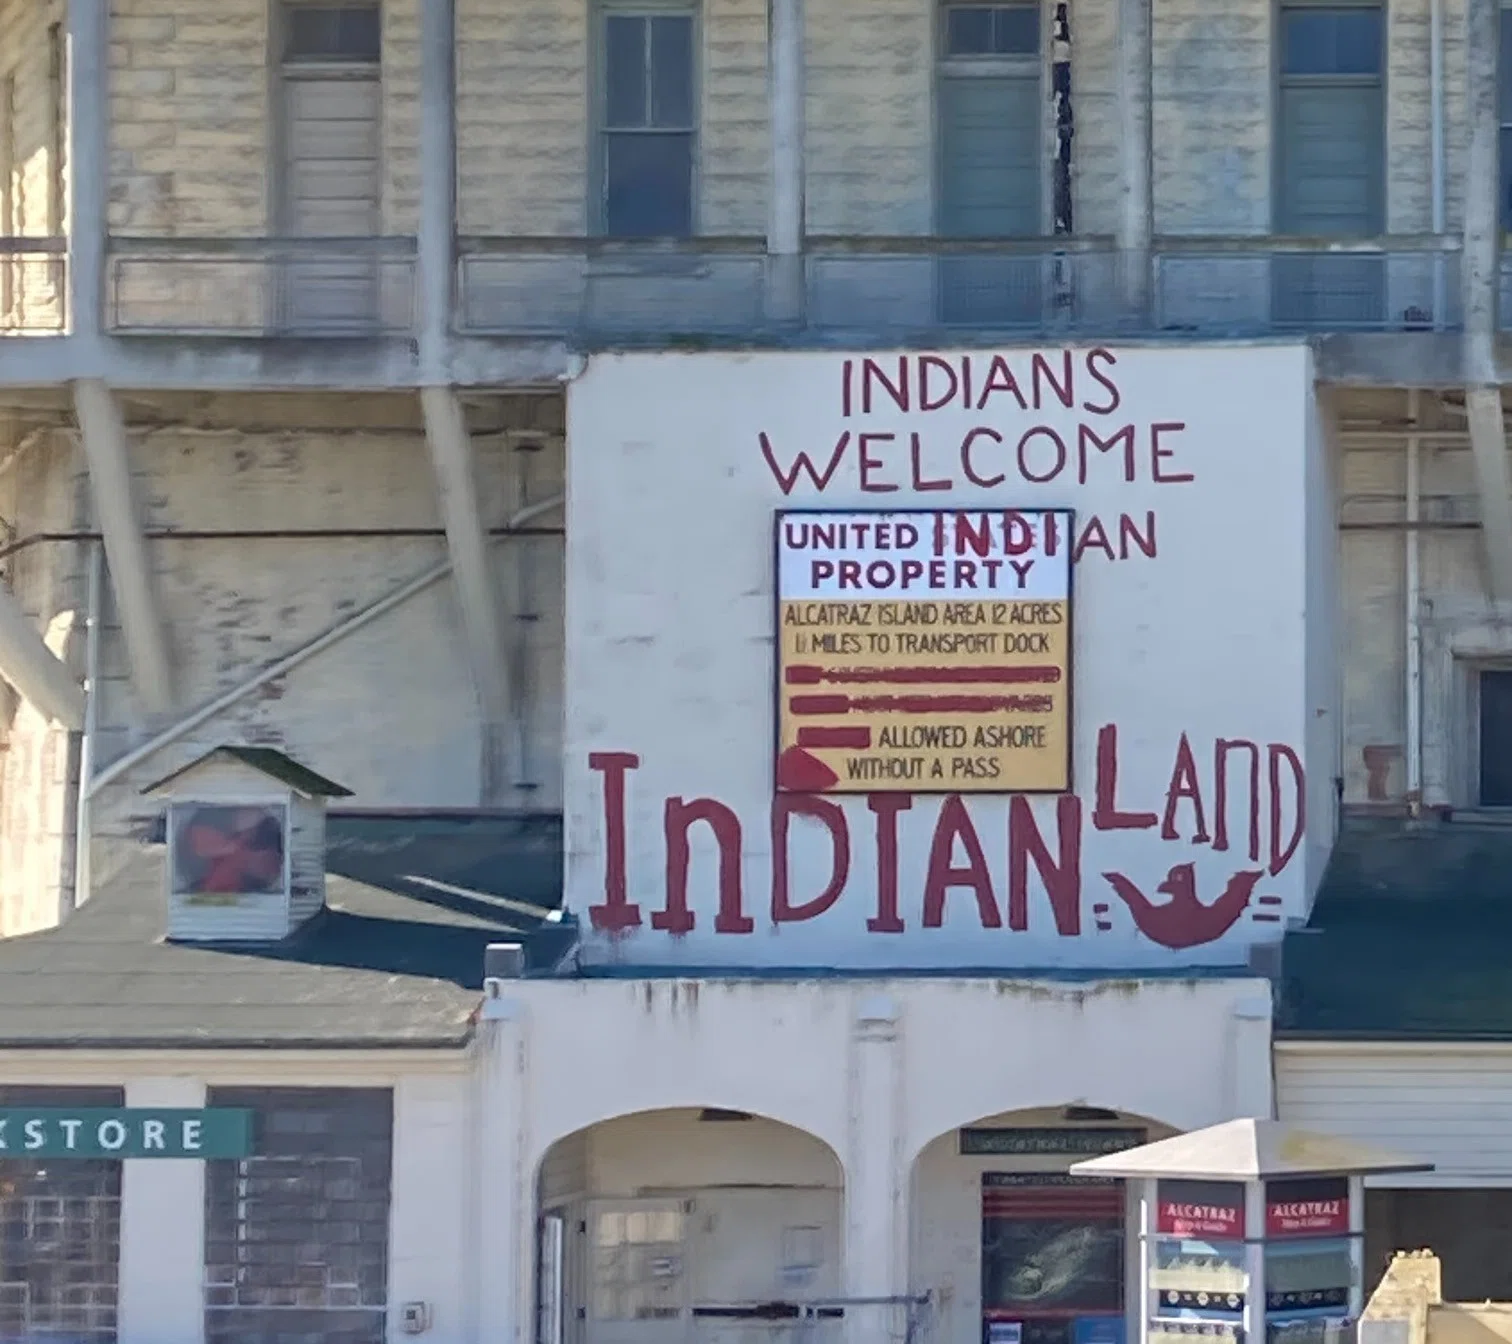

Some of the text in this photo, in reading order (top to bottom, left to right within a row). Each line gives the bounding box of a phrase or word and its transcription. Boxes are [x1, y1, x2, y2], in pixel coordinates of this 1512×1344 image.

[842, 348, 1121, 417] INDIANS
[758, 422, 1196, 495] WELCOME
[785, 523, 919, 549] UNITED
[811, 560, 1035, 589] PROPERTY
[785, 602, 1063, 625] ALCATRAZ ISLAND AREA 12 ACRES
[812, 634, 862, 654] MILES
[867, 633, 890, 653] TO
[895, 633, 998, 654] TRANSPORT
[1003, 632, 1050, 653] DOCK
[878, 725, 1047, 748] ALLOWED ASHORE
[847, 757, 1001, 779] WITHOUT A PASS
[1167, 1203, 1236, 1223] ALCATRAZ
[1273, 1200, 1340, 1216] ALCATRAZ
